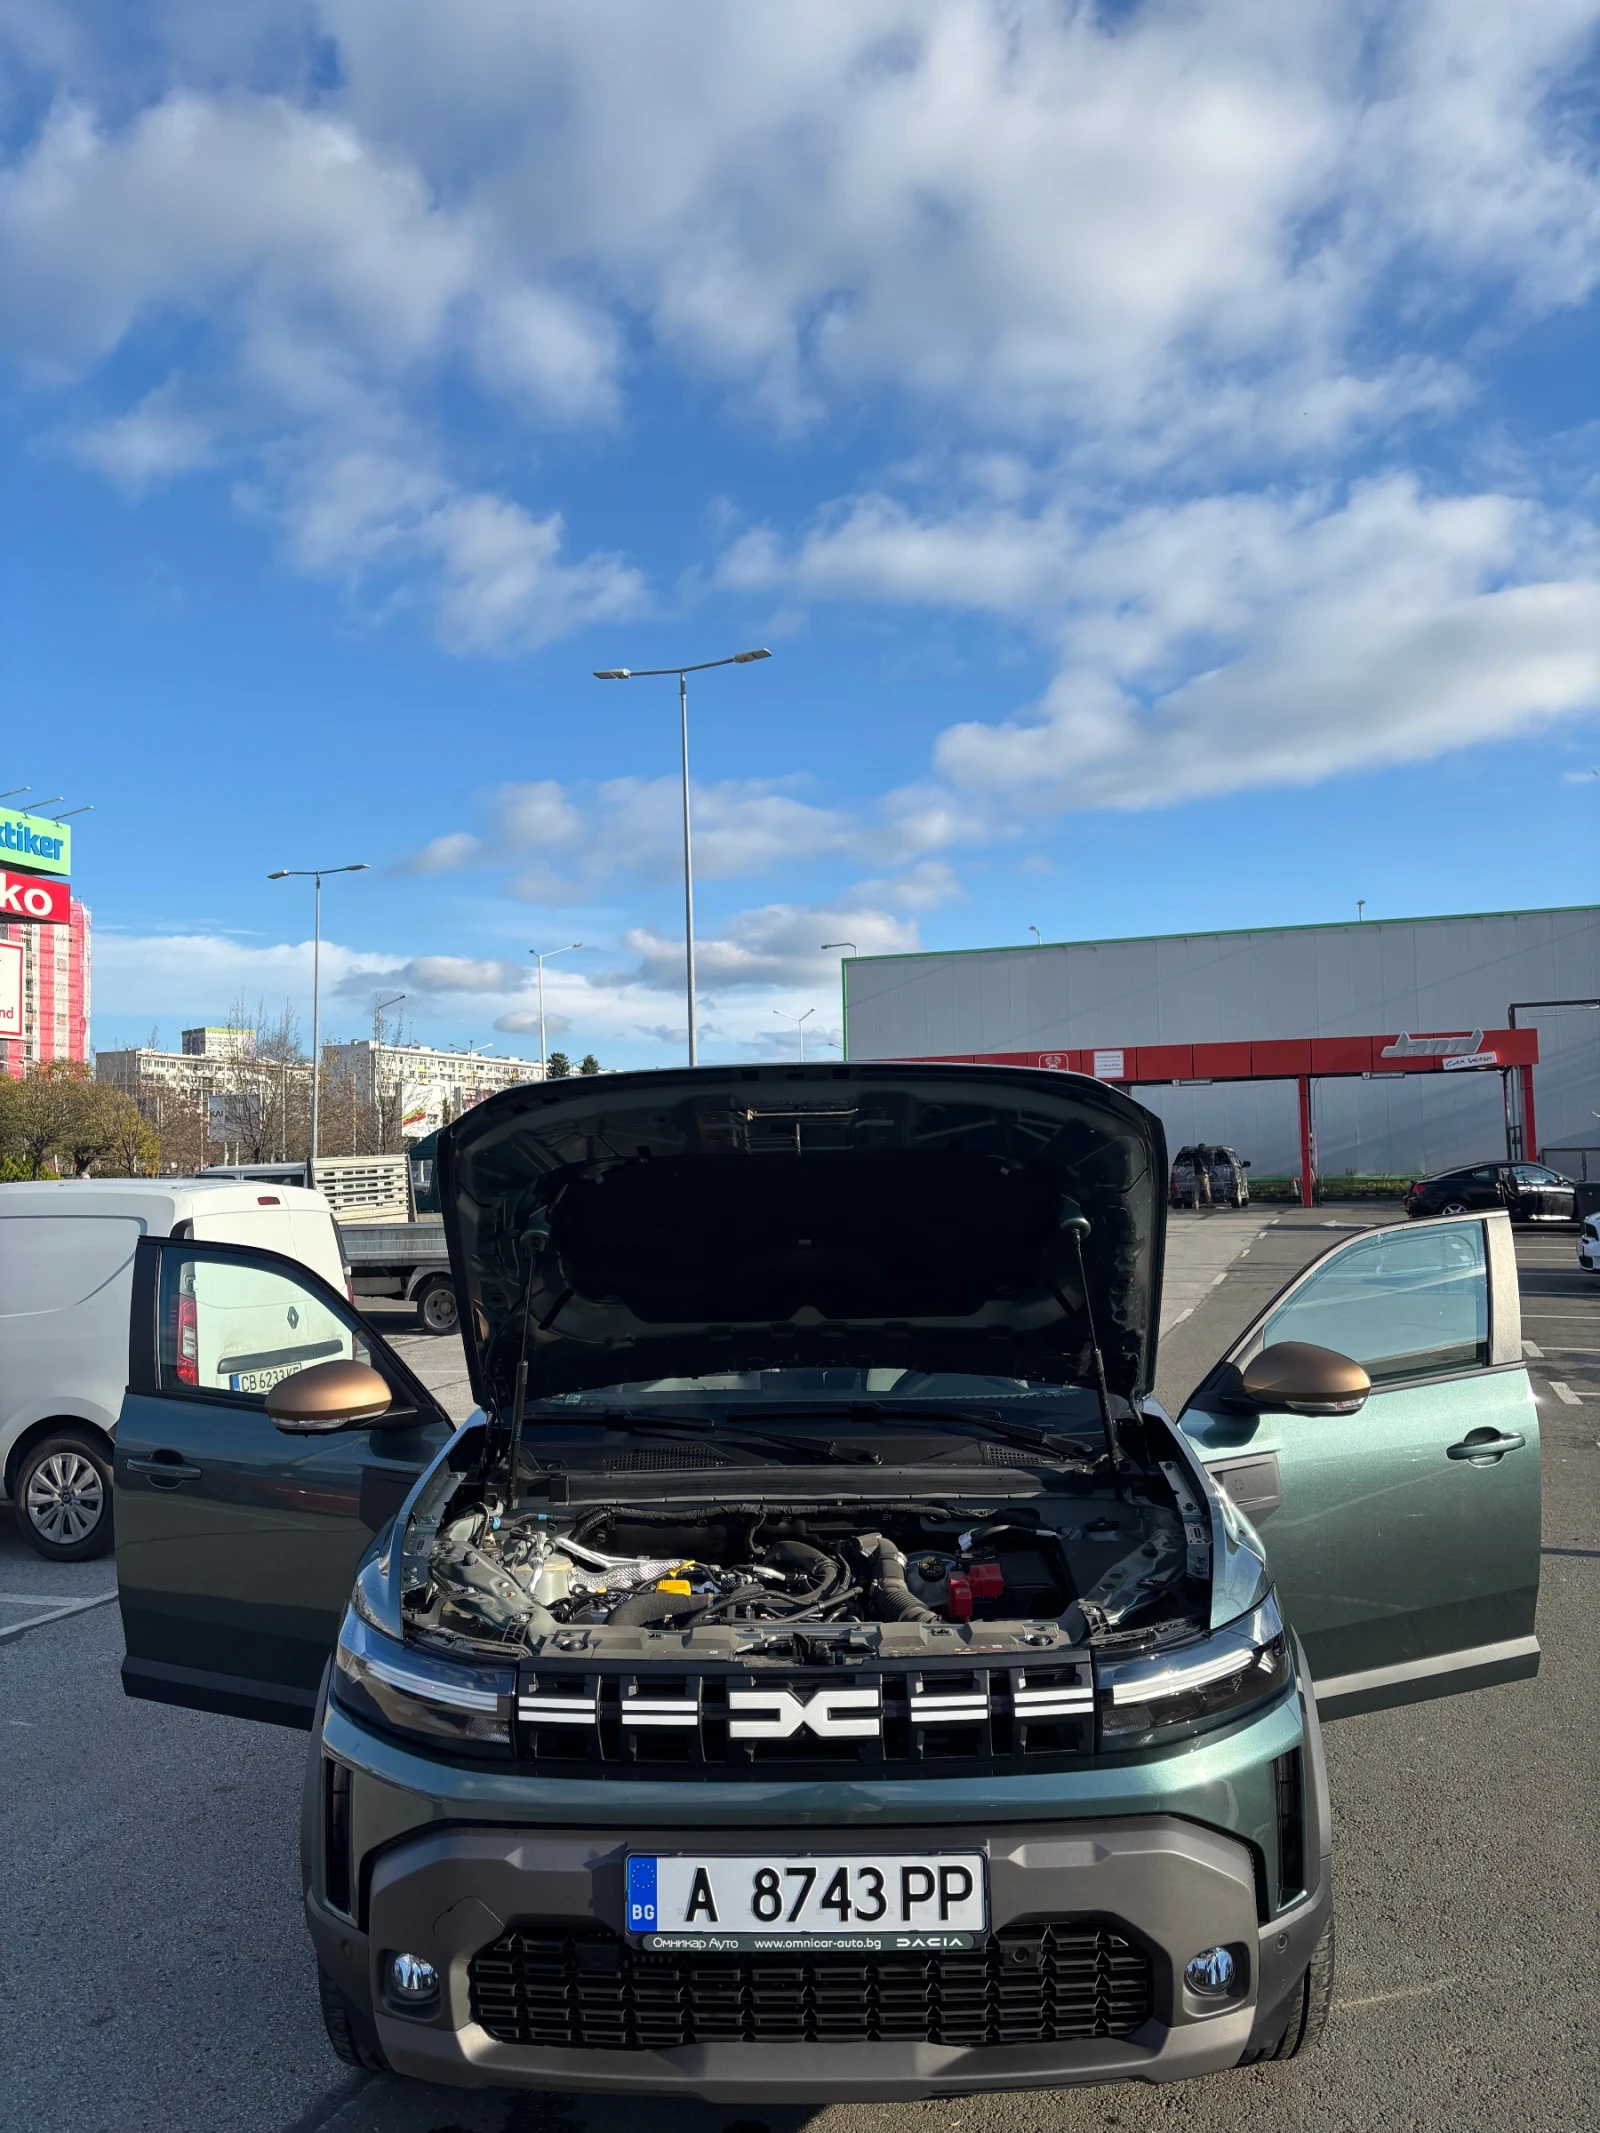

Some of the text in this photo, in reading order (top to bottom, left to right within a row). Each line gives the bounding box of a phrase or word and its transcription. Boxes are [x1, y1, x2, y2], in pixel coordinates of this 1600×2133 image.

[242, 1375, 257, 1392] CB
[632, 1865, 974, 1923] BG A 8743 PP
[652, 1937, 739, 1950] Омникар Ауто
[754, 1938, 882, 1950] www.omnicar-auto.bg
